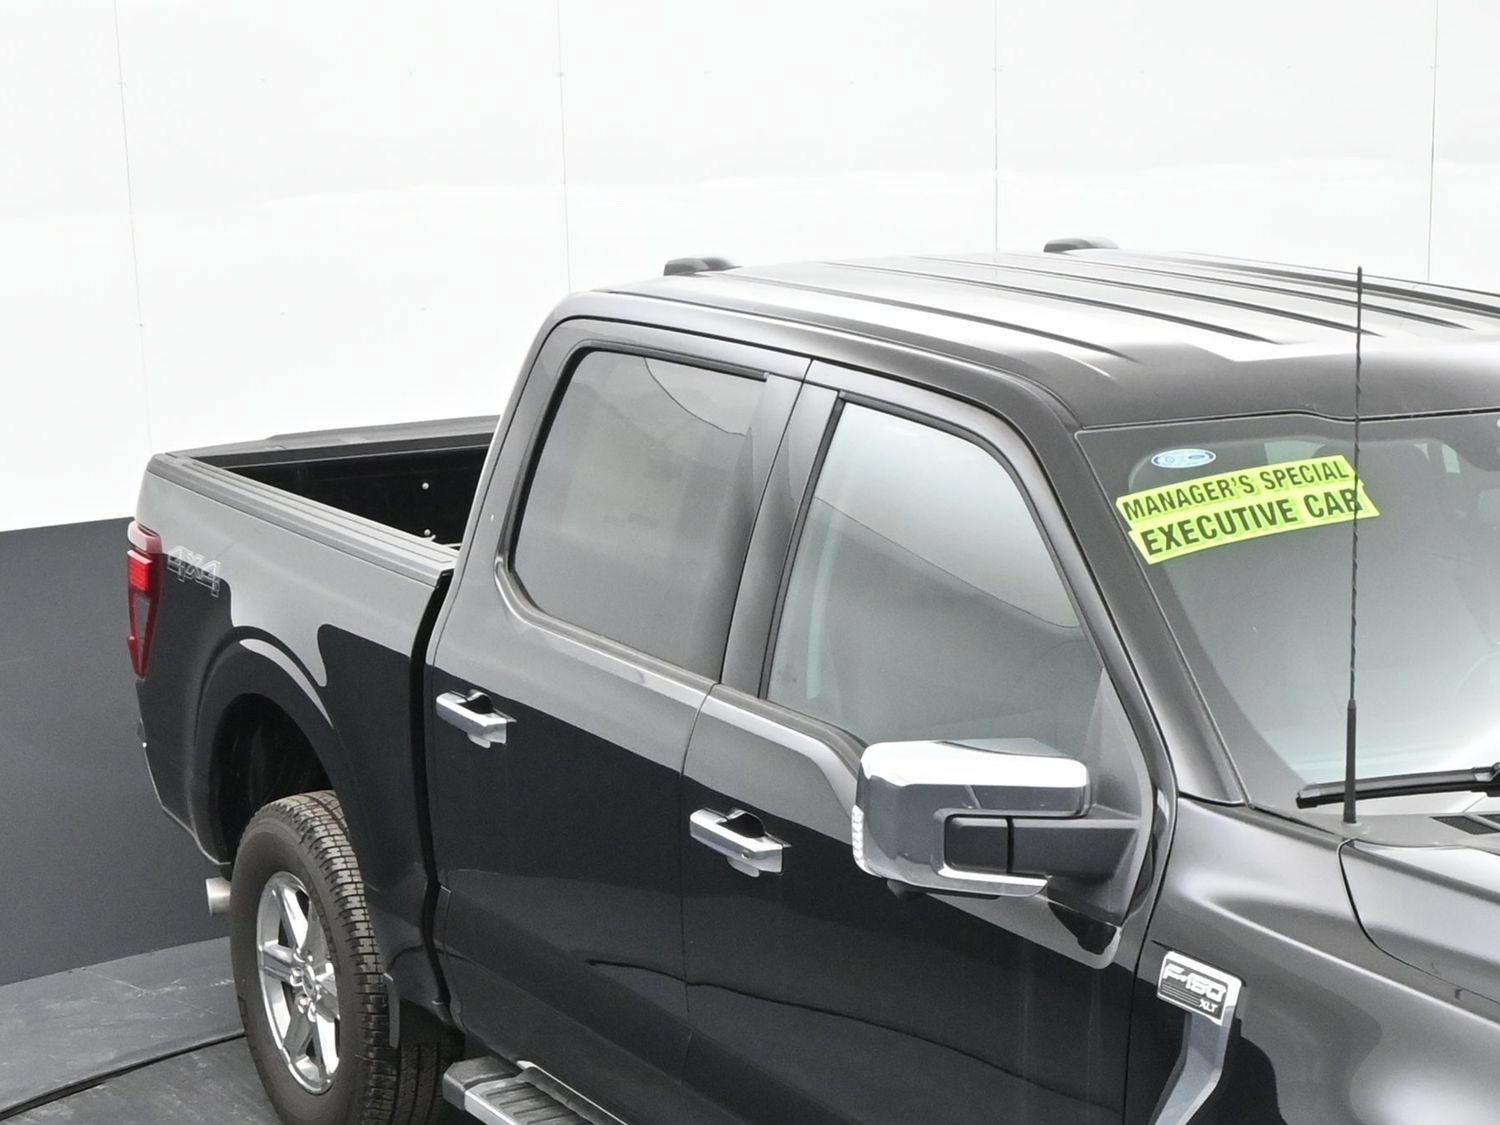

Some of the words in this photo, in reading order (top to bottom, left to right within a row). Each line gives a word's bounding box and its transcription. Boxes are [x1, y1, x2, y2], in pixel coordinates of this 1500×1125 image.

[1122, 475, 1255, 520] MANAGER'S
[1260, 461, 1349, 490] SPECIAL
[1140, 498, 1298, 556] EXECUTIVE
[1163, 963, 1227, 1003] F-150
[1199, 998, 1219, 1013] XLT
